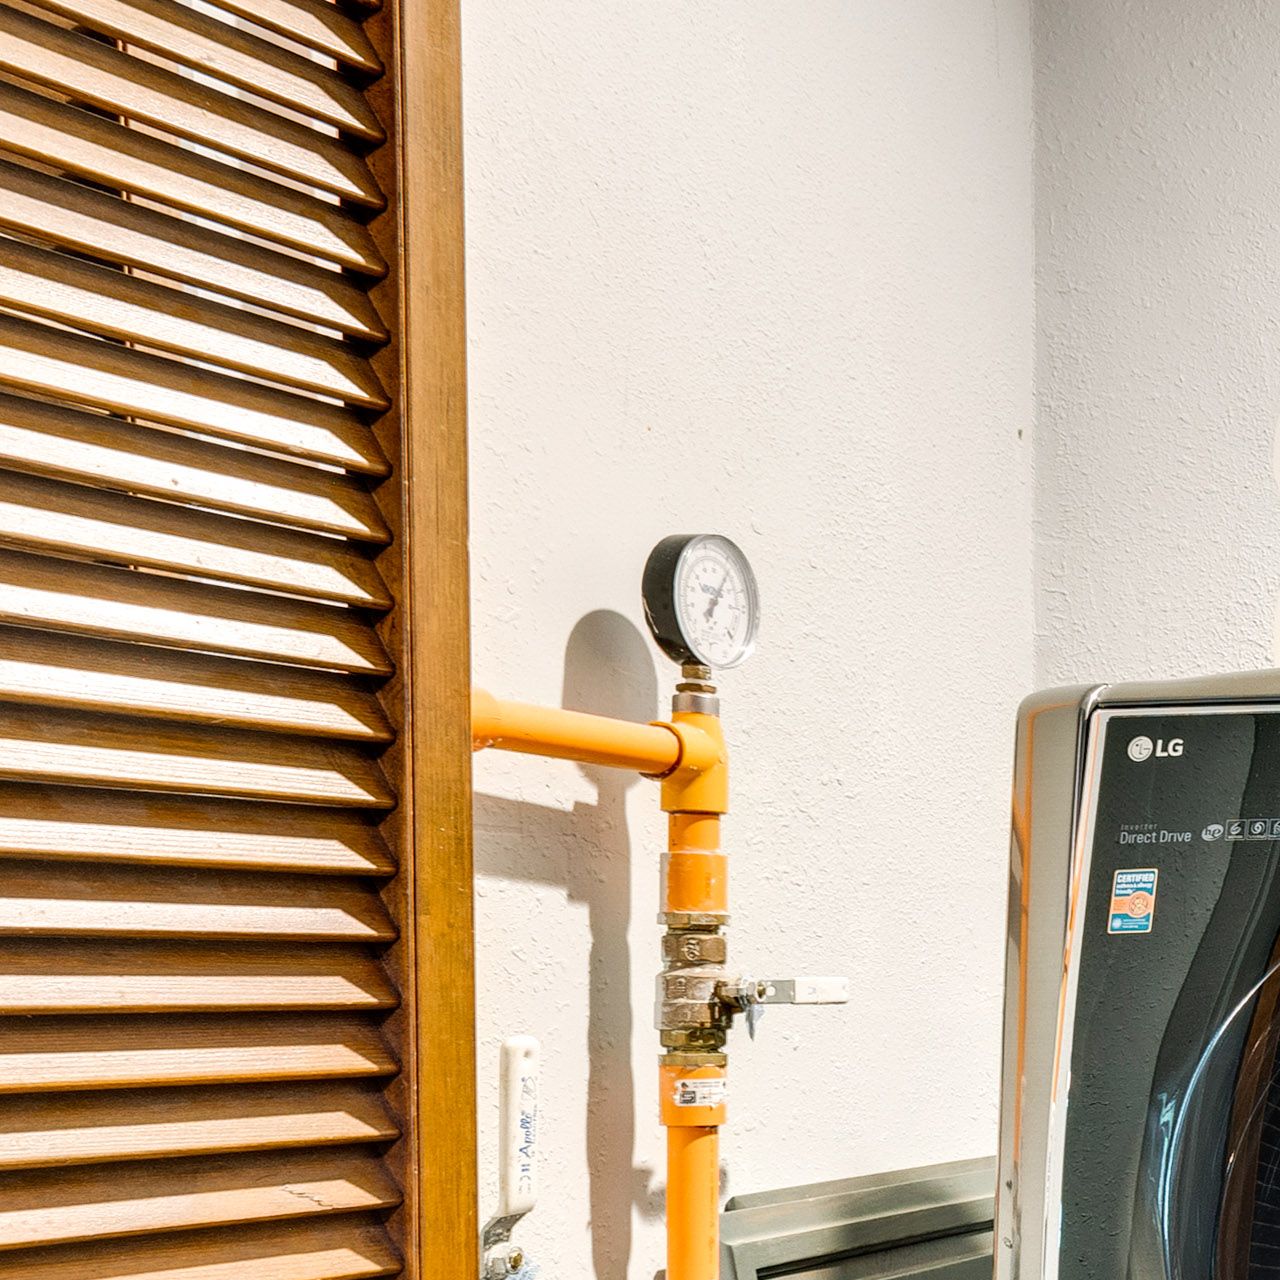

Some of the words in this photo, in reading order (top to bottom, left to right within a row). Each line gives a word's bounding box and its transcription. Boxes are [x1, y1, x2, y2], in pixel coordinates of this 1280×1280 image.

[1155, 737, 1184, 757] LG
[1119, 831, 1158, 845] Direct
[1159, 829, 1193, 843] Drive
[518, 1112, 535, 1159] Apollo
